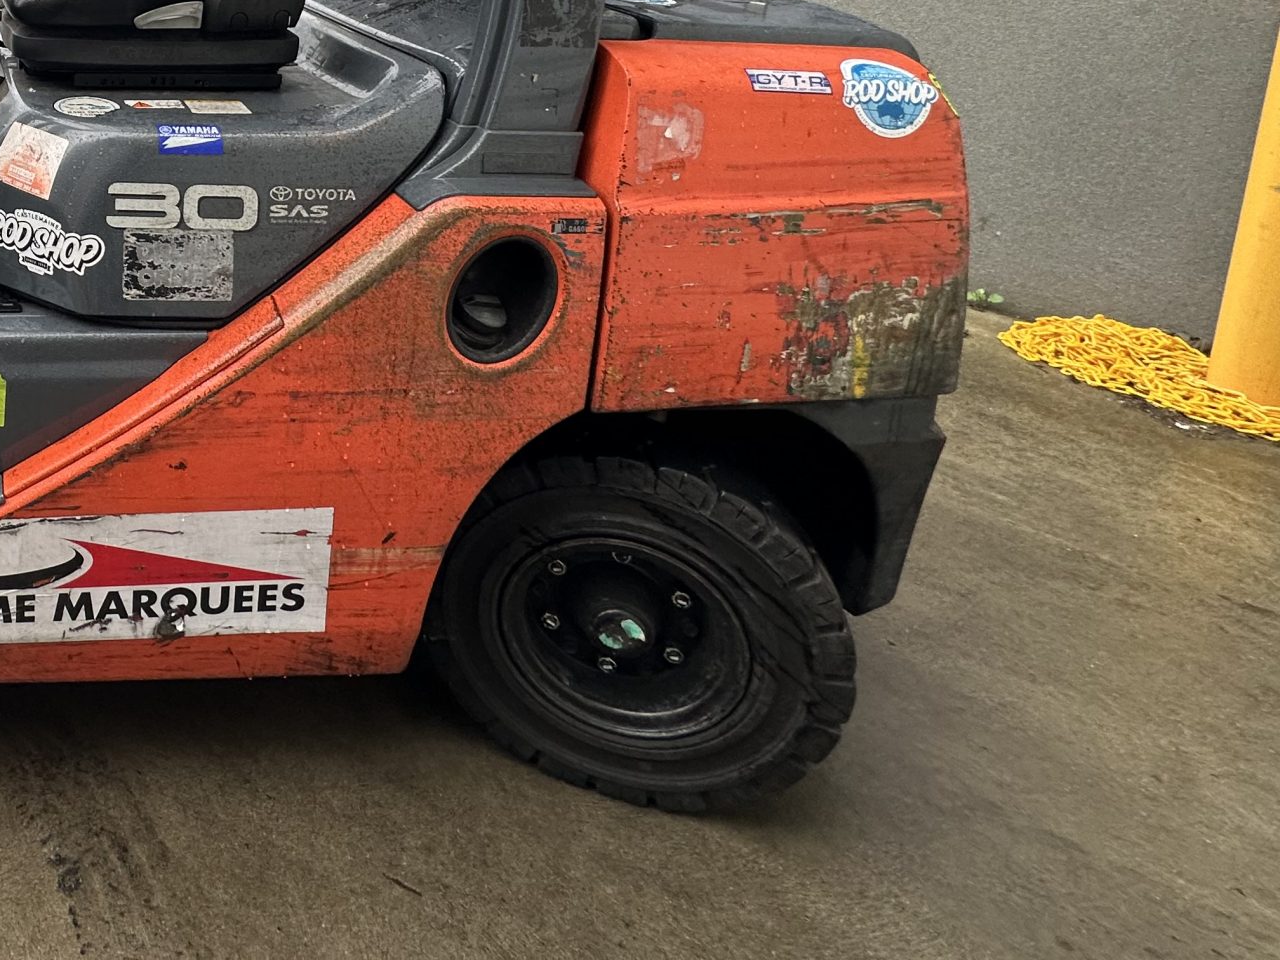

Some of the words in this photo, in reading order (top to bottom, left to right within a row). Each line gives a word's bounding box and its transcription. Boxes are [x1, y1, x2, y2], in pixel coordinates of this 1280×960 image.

[845, 80, 885, 104] ROD
[886, 79, 936, 105] SHOP
[172, 126, 219, 134] YAMAHA
[106, 182, 259, 231] 30
[295, 188, 356, 201] TOYOTA
[269, 204, 329, 218] SAS
[30, 227, 101, 273] SHOP
[52, 582, 306, 624] MARQUEES
